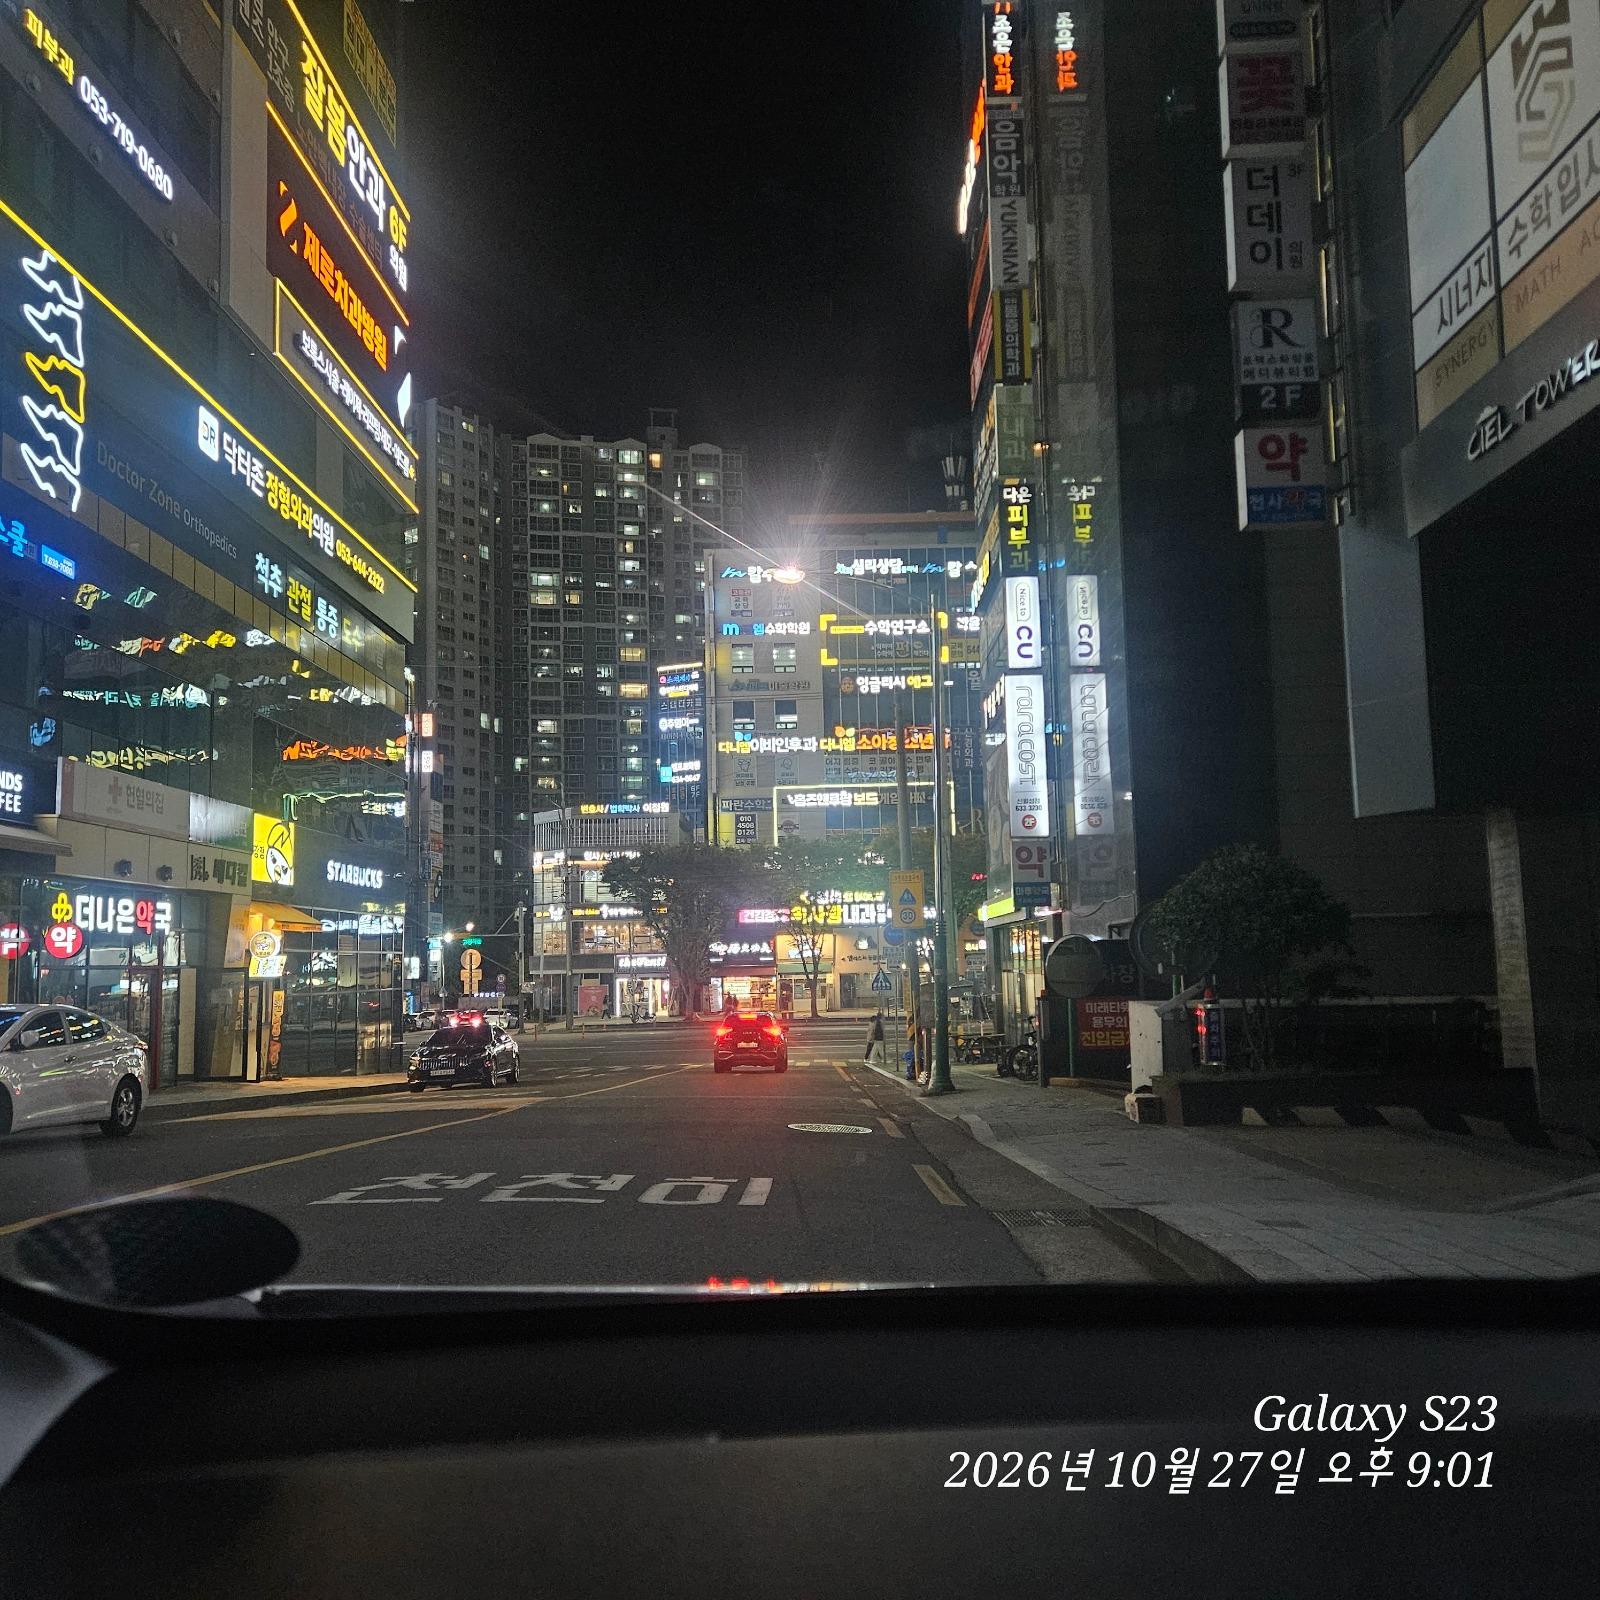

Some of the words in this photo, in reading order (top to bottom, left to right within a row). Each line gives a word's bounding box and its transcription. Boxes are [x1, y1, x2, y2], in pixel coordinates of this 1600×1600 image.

[25, 8, 75, 86] 피부과
[80, 75, 174, 201] 053-719-0680
[1437, 245, 1493, 335] 시너지
[1514, 255, 1561, 314] MATH
[1434, 319, 1497, 389] SYNERGY
[1260, 385, 1302, 409] 2F
[1467, 410, 1513, 461] CIEL
[1257, 431, 1308, 482] 약
[97, 440, 145, 494] Doctor
[149, 479, 181, 519] Zone
[183, 508, 238, 560] Orthopedics
[1002, 485, 1033, 504] 다온
[255, 552, 283, 598] 척추
[287, 576, 313, 623] 관절
[315, 596, 339, 639] 통증
[1016, 625, 1033, 659] CU
[126, 783, 164, 815] 헌혈의집
[326, 859, 383, 889] STARBUCKS
[1015, 845, 1048, 878] 약
[75, 894, 172, 935] 더나은약국
[51, 926, 77, 953] 약
[1080, 1030, 1129, 1047] 진입금
[304, 1171, 774, 1207] 천천히
